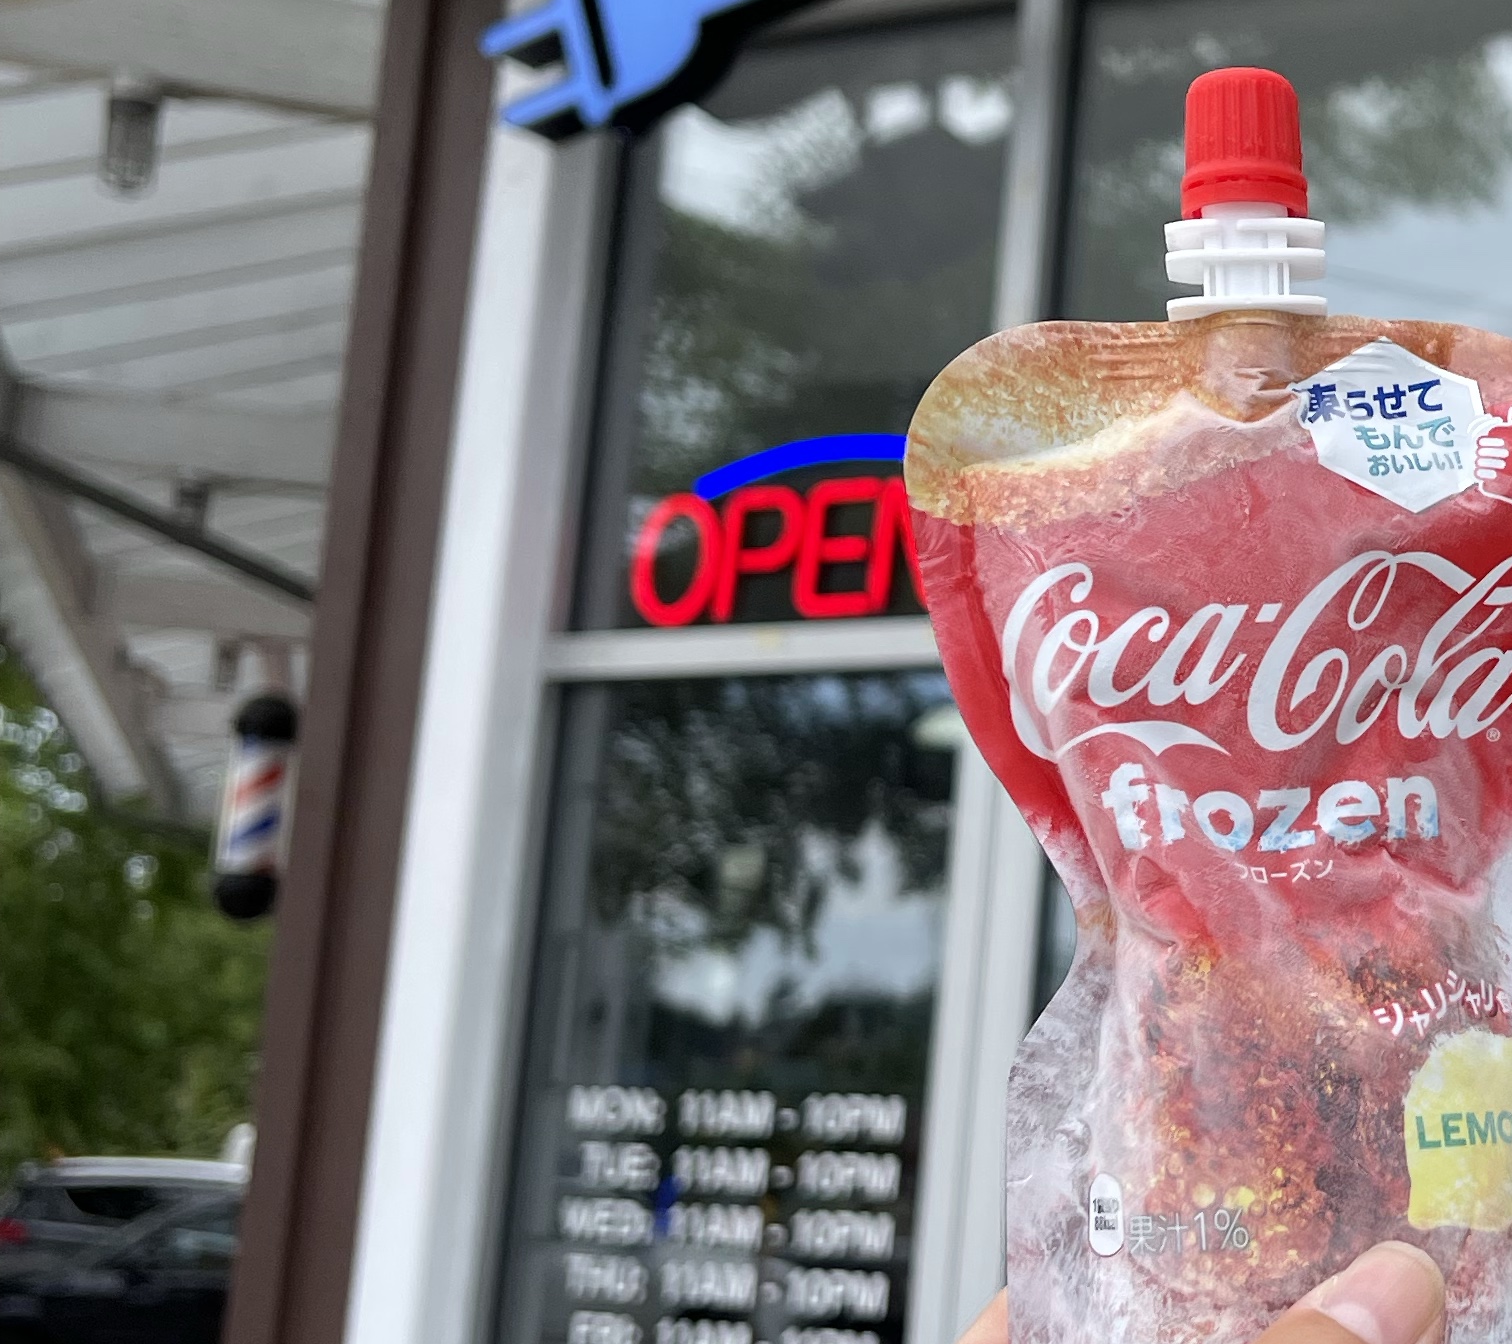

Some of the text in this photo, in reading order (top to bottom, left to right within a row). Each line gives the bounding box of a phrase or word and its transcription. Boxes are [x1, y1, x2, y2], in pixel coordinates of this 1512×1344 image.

[1353, 415, 1456, 450] もんで
[1101, 761, 1440, 852] frozen
[676, 1088, 777, 1139] 11AM
[673, 1146, 771, 1196] 11AM
[667, 1203, 764, 1253] 11AM
[1129, 1208, 1250, 1254] 果汁1%
[660, 1260, 758, 1310] 11AM
